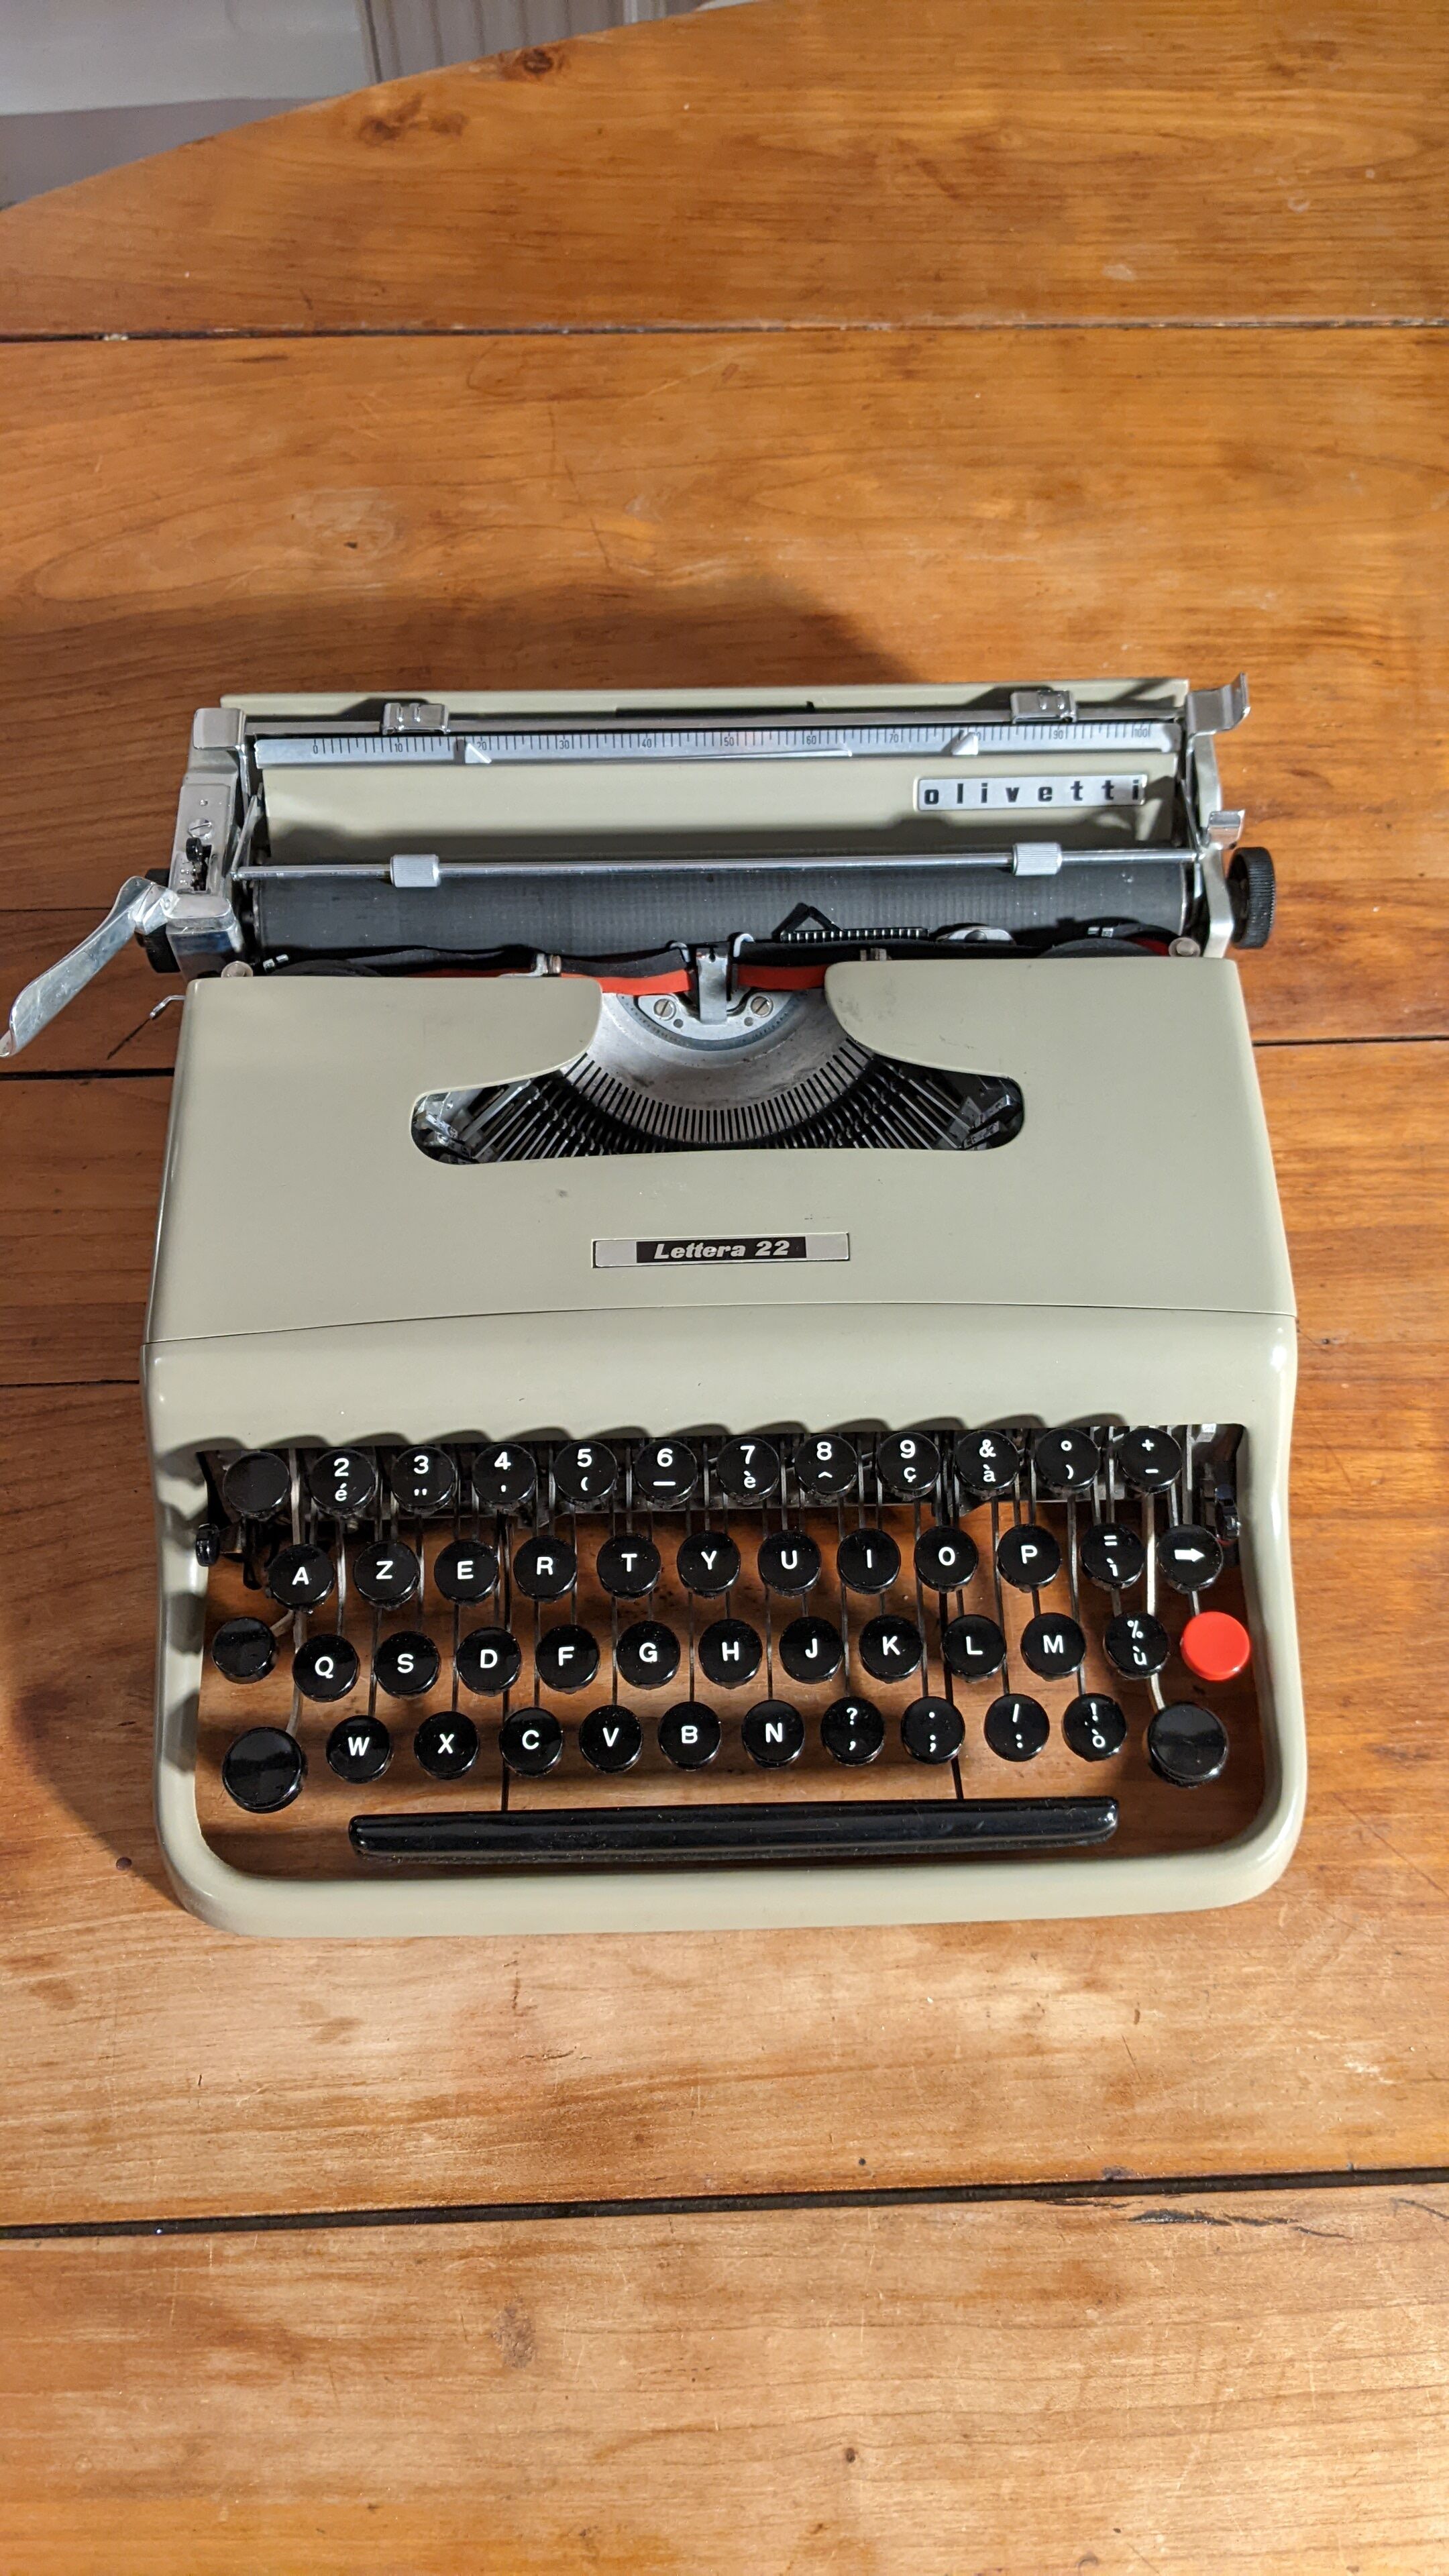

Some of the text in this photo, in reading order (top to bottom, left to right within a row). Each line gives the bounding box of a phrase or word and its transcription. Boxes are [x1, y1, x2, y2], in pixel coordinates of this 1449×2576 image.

[313, 745, 319, 754] 0
[394, 743, 403, 752] 10
[559, 739, 570, 749] 30
[641, 738, 653, 748] 40
[724, 736, 735, 747] 50
[806, 735, 816, 745] 60
[889, 733, 899, 743] 70
[1053, 729, 1064, 740] 90
[924, 779, 1140, 805] olivetti
[654, 1240, 790, 1259] Lettera 22
[740, 1445, 755, 1464] 7
[816, 1441, 833, 1461] 8
[900, 1440, 916, 1459] 9
[979, 1439, 997, 1458] &
[1141, 1439, 1155, 1452] +
[333, 1457, 350, 1477] 2
[413, 1454, 429, 1474] 3
[494, 1451, 512, 1470] 4
[577, 1448, 592, 1468] 5
[657, 1448, 674, 1468] 6
[743, 1470, 756, 1489] è
[904, 1466, 917, 1483] ç
[983, 1464, 996, 1483] à
[335, 1483, 347, 1502] é
[1104, 1535, 1118, 1546] =
[621, 1553, 638, 1572] T
[700, 1550, 717, 1570] Y
[781, 1550, 798, 1570] U
[866, 1549, 872, 1568] I
[938, 1546, 956, 1566] O
[1020, 1544, 1038, 1564] P
[292, 1566, 309, 1585] A
[376, 1560, 394, 1580] Z
[457, 1560, 474, 1580] E
[536, 1556, 553, 1575] R
[1127, 1619, 1144, 1639] %
[639, 1642, 658, 1664] G
[721, 1641, 739, 1662] H
[805, 1638, 818, 1658] J
[882, 1635, 901, 1656] K
[965, 1635, 983, 1656] L
[1042, 1634, 1064, 1654] M
[397, 1653, 414, 1674] S
[480, 1649, 498, 1669] D
[558, 1646, 575, 1666] F
[315, 1656, 334, 1679] Q
[846, 1707, 858, 1725] ?
[522, 1729, 539, 1750] C
[602, 1727, 619, 1748] V
[681, 1725, 698, 1744] B
[765, 1722, 783, 1743] N
[347, 1736, 370, 1756] W
[437, 1733, 455, 1754] X
[929, 1734, 936, 1753] ;
